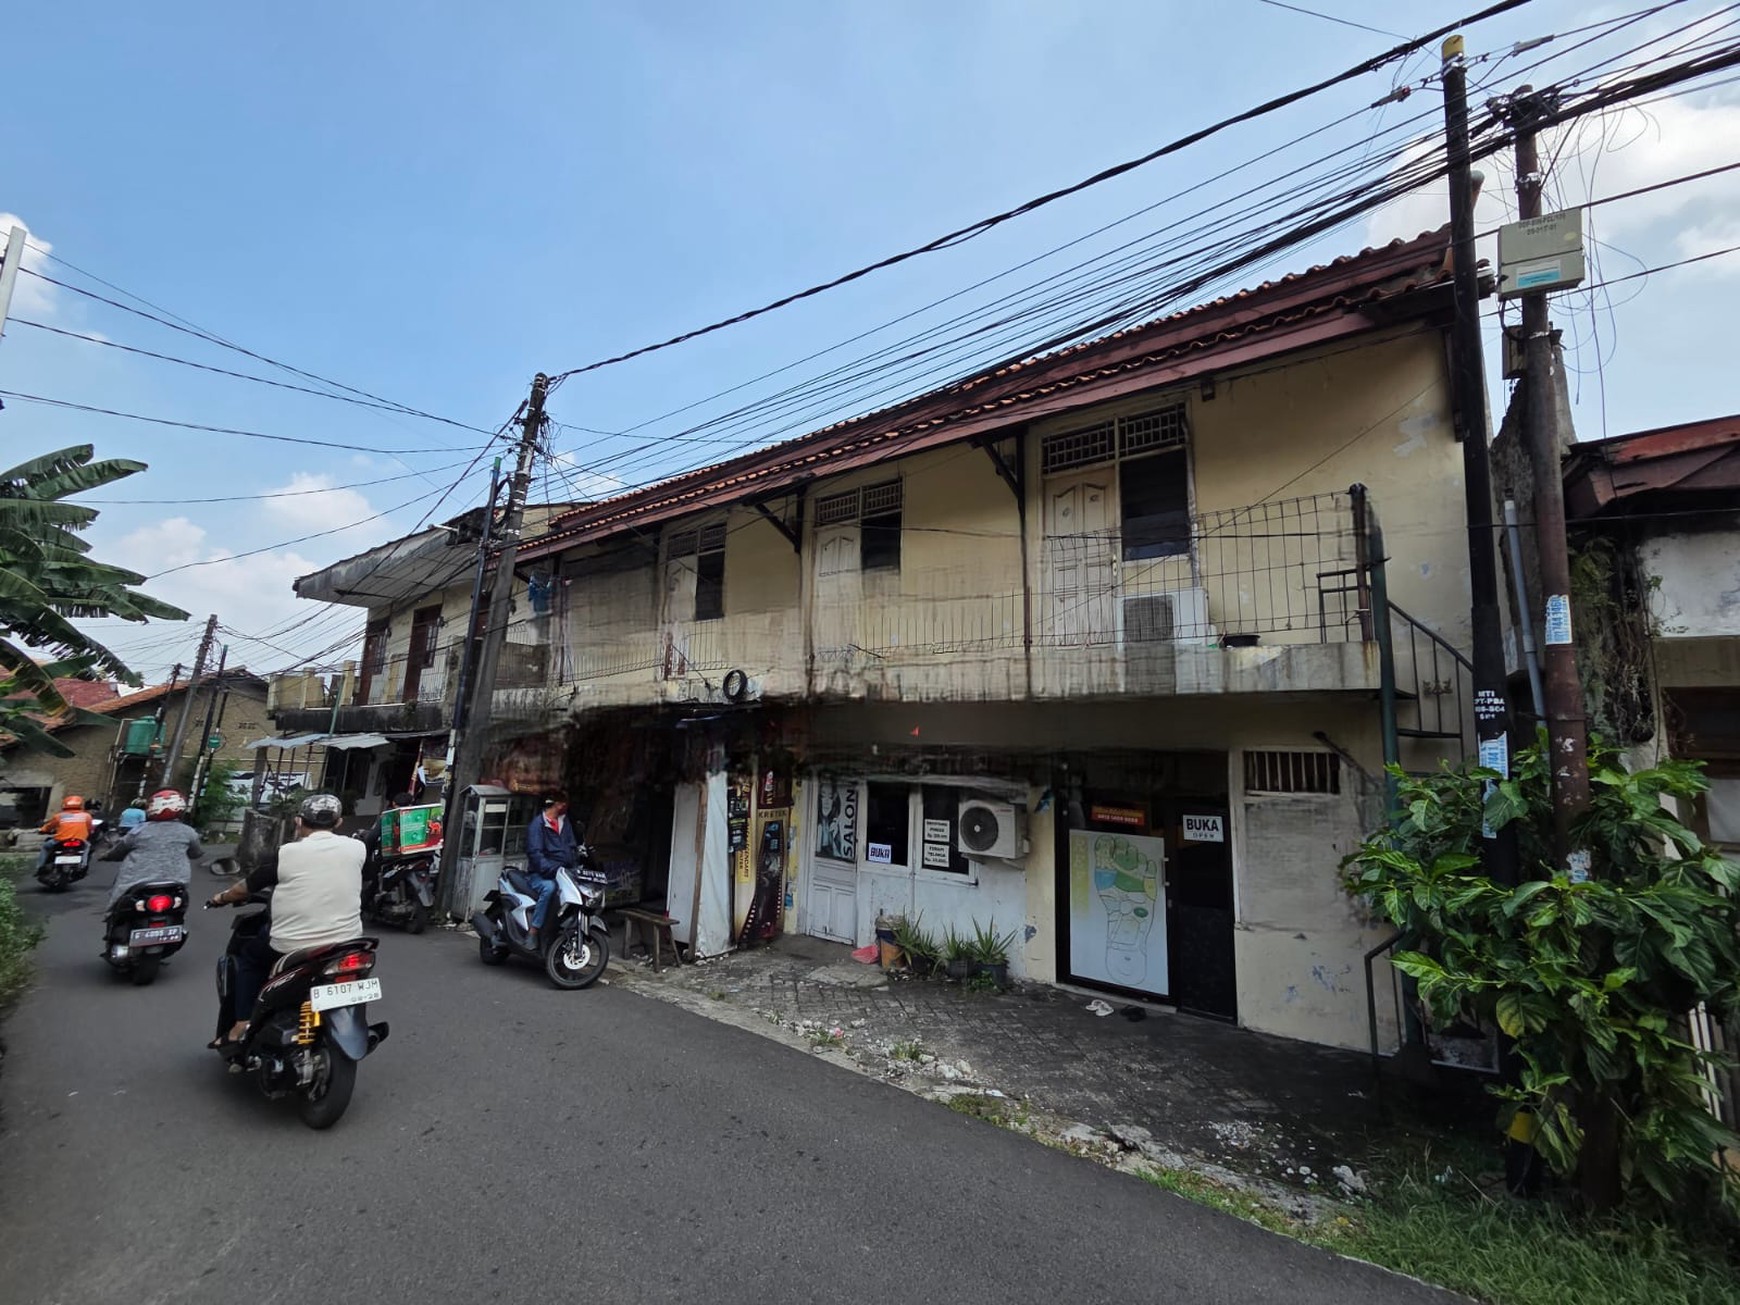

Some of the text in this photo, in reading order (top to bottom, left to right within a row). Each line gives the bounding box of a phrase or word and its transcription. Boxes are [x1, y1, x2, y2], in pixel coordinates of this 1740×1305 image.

[759, 810, 787, 819] KRETEK
[843, 789, 856, 858] SALON
[1186, 818, 1219, 832] BUKA
[313, 980, 378, 999] B 6107 WJM
